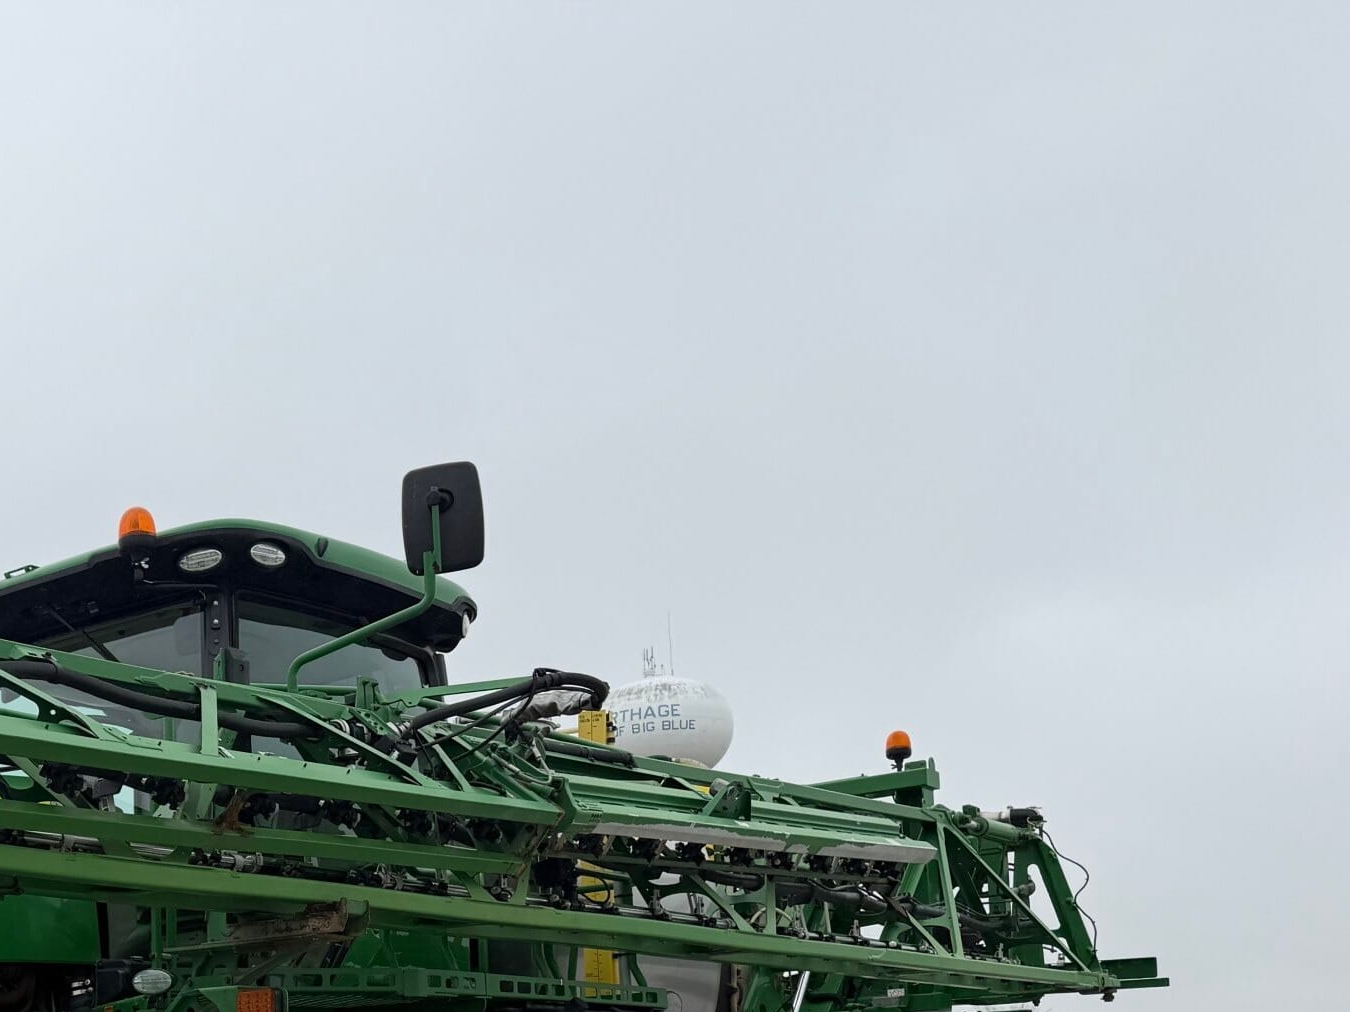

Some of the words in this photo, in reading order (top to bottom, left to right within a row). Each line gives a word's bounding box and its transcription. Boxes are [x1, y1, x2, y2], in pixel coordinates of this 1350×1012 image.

[612, 704, 680, 724] RTHAGE
[632, 722, 655, 734] BIG
[662, 720, 696, 730] BLUE
